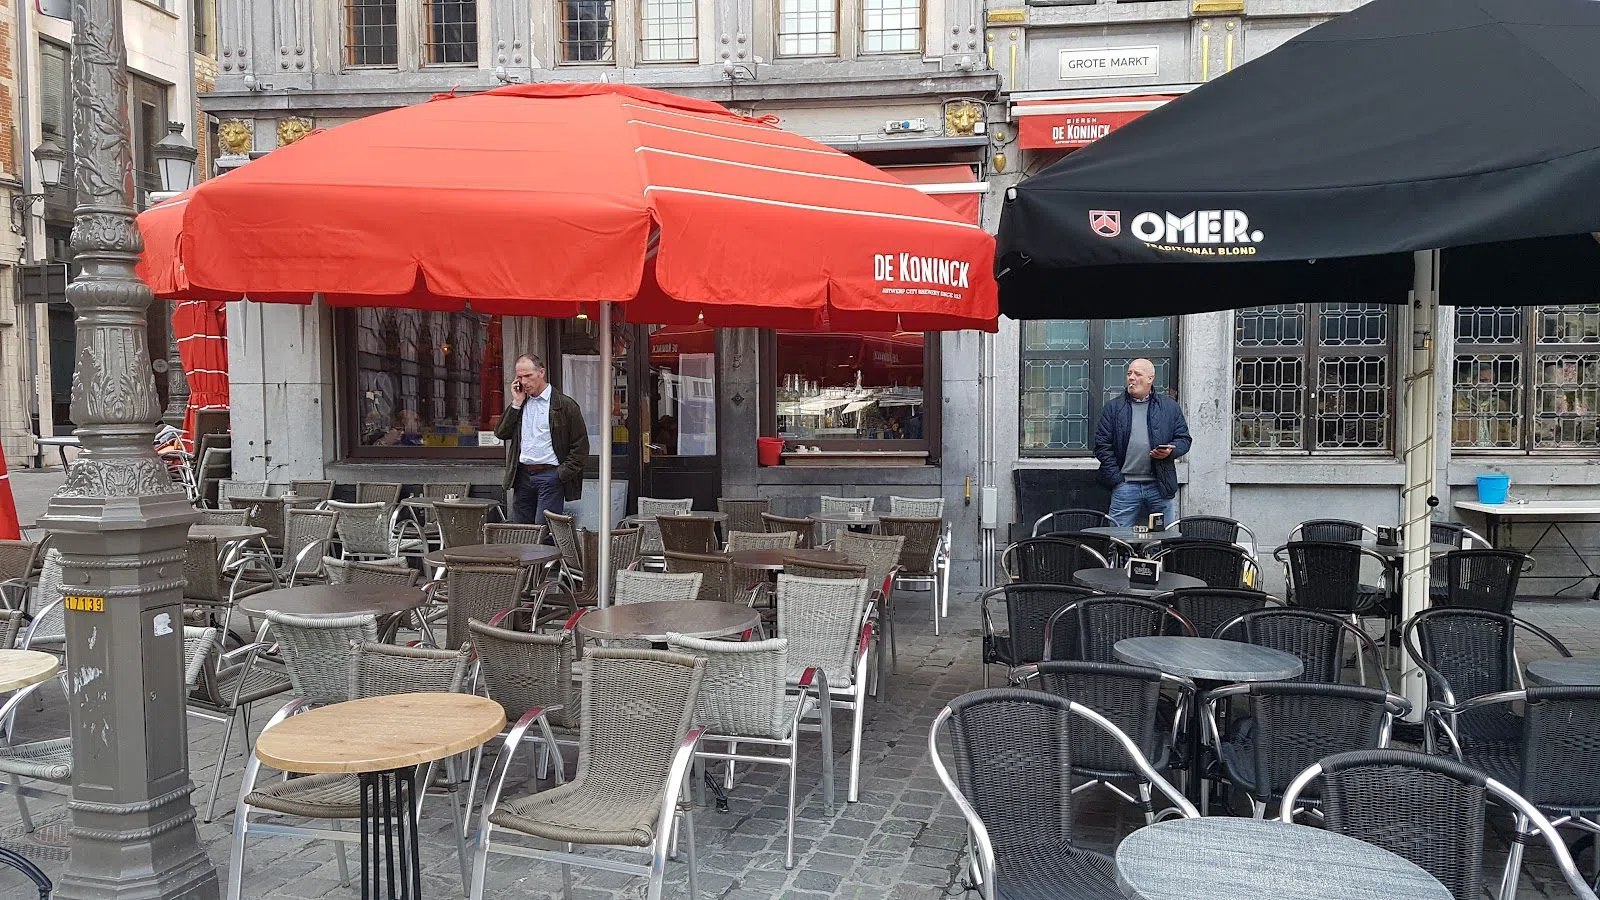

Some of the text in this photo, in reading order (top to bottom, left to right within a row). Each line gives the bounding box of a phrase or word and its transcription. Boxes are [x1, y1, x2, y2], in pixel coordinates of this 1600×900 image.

[1068, 56, 1150, 69] GROTE MARKT
[1052, 124, 1111, 140] DE KONINCK
[1144, 242, 1257, 255] TRADITIONAL BLOND
[874, 252, 970, 288] DE KONINCK
[68, 597, 101, 611] 17139
